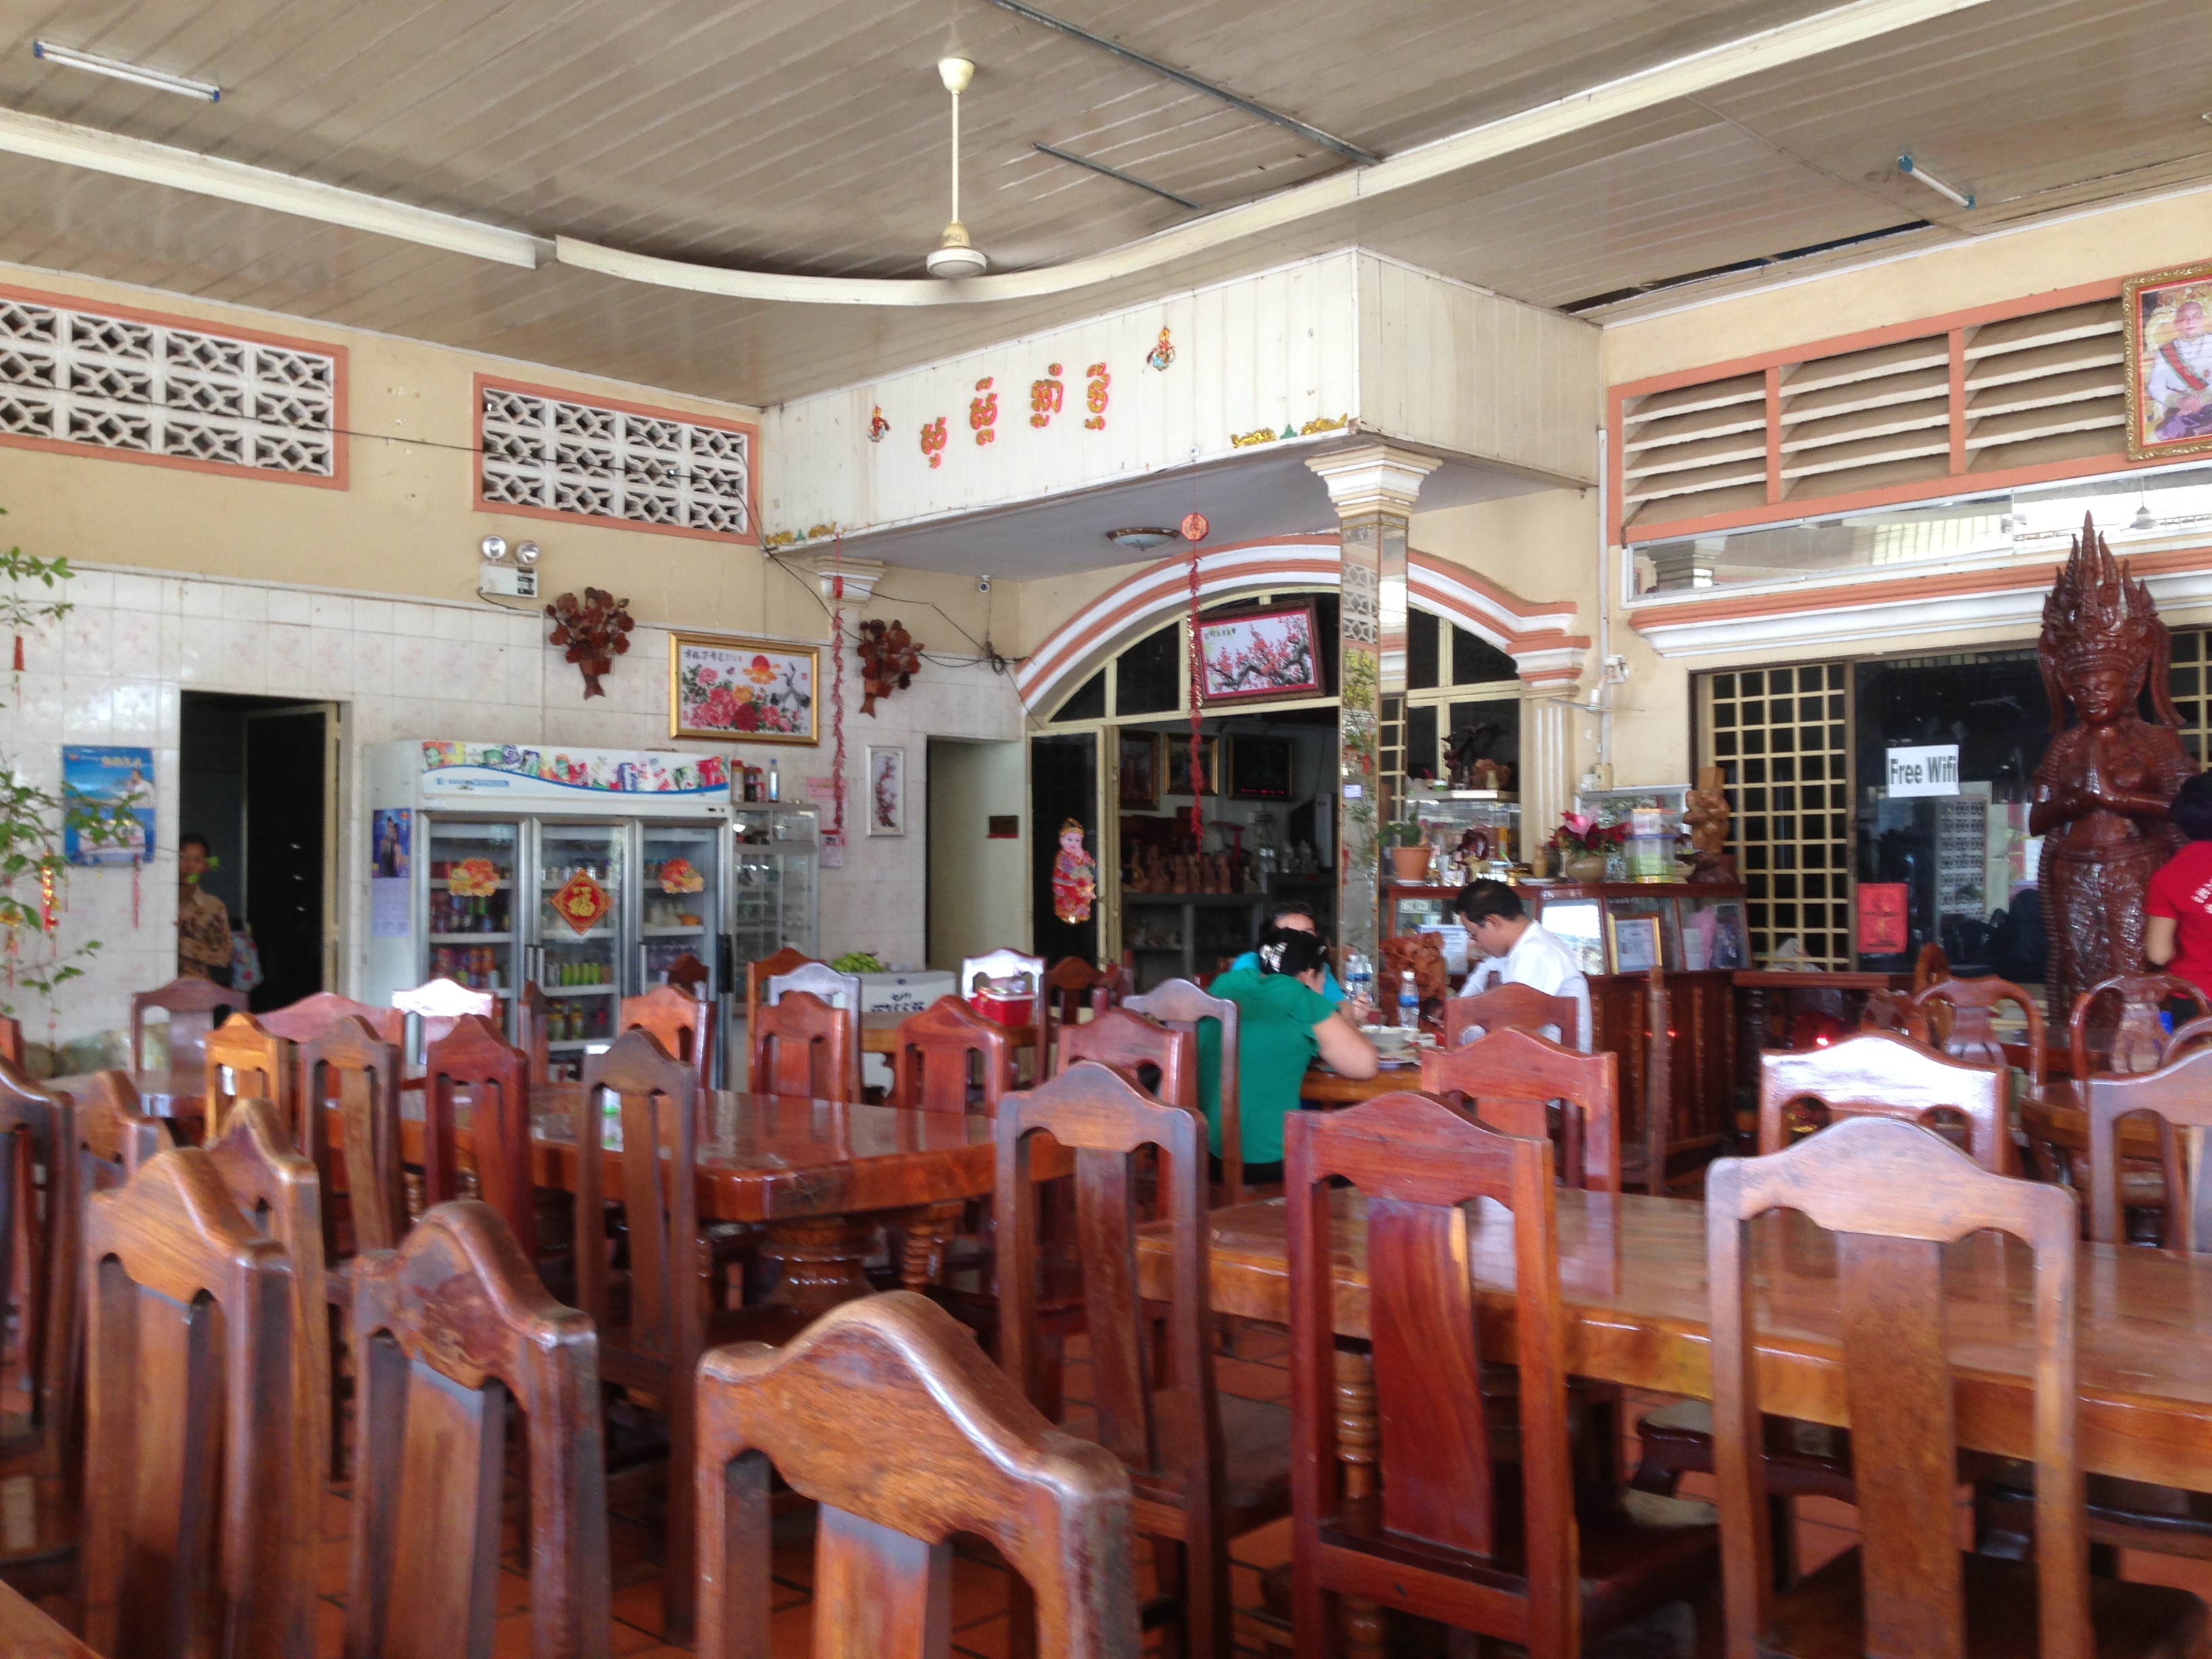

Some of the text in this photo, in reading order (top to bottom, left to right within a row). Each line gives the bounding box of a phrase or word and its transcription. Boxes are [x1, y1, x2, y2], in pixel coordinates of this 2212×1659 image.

[1890, 755, 1957, 785] Free Wifi
[568, 886, 596, 917] 福
